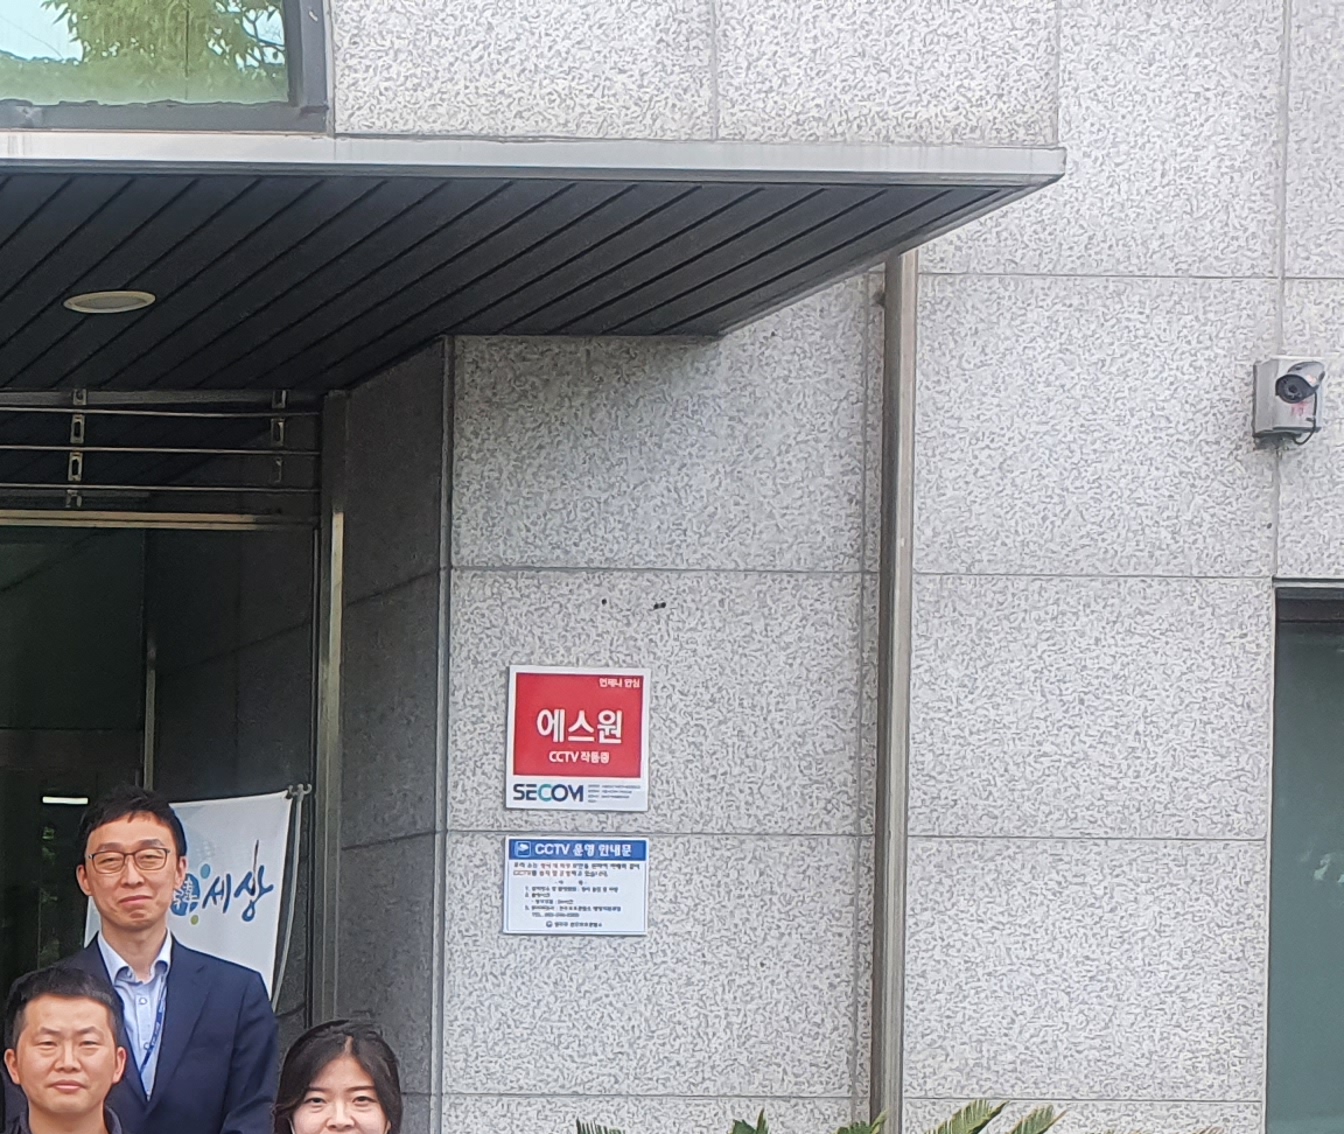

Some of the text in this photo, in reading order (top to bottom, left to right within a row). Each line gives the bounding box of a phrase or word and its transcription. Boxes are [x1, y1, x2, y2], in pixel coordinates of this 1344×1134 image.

[537, 709, 622, 744] 에스원
[549, 751, 579, 763] CCTV
[513, 783, 584, 802] SECOM
[535, 843, 631, 857] CCTV 운영 안내문
